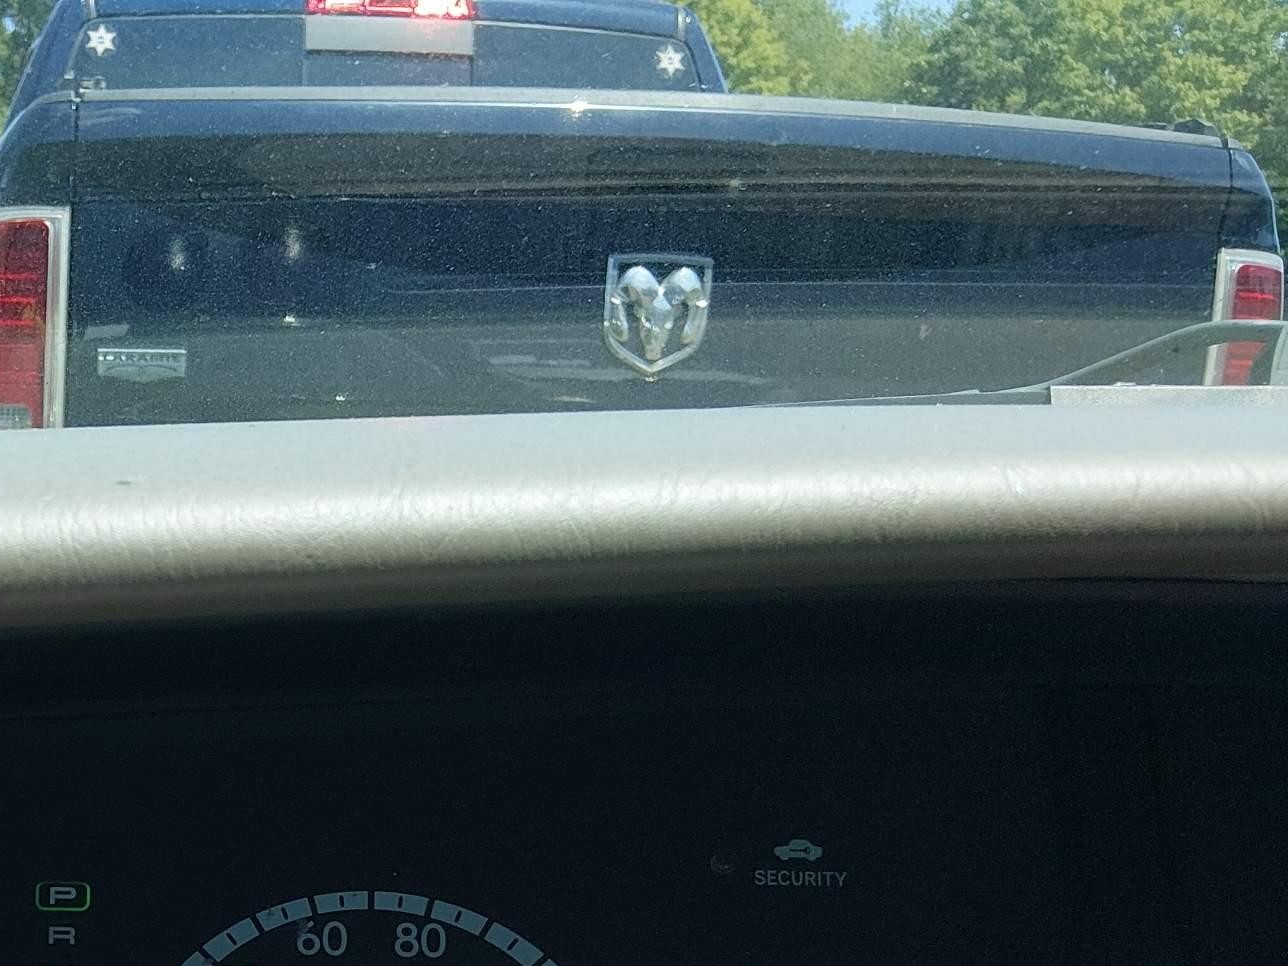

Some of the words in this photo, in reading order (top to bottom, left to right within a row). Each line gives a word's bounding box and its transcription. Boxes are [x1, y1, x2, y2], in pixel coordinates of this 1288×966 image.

[755, 870, 846, 886] SECURITY
[50, 887, 76, 904] P
[49, 927, 75, 944] R
[296, 920, 347, 956] 60
[394, 921, 448, 957] 80
